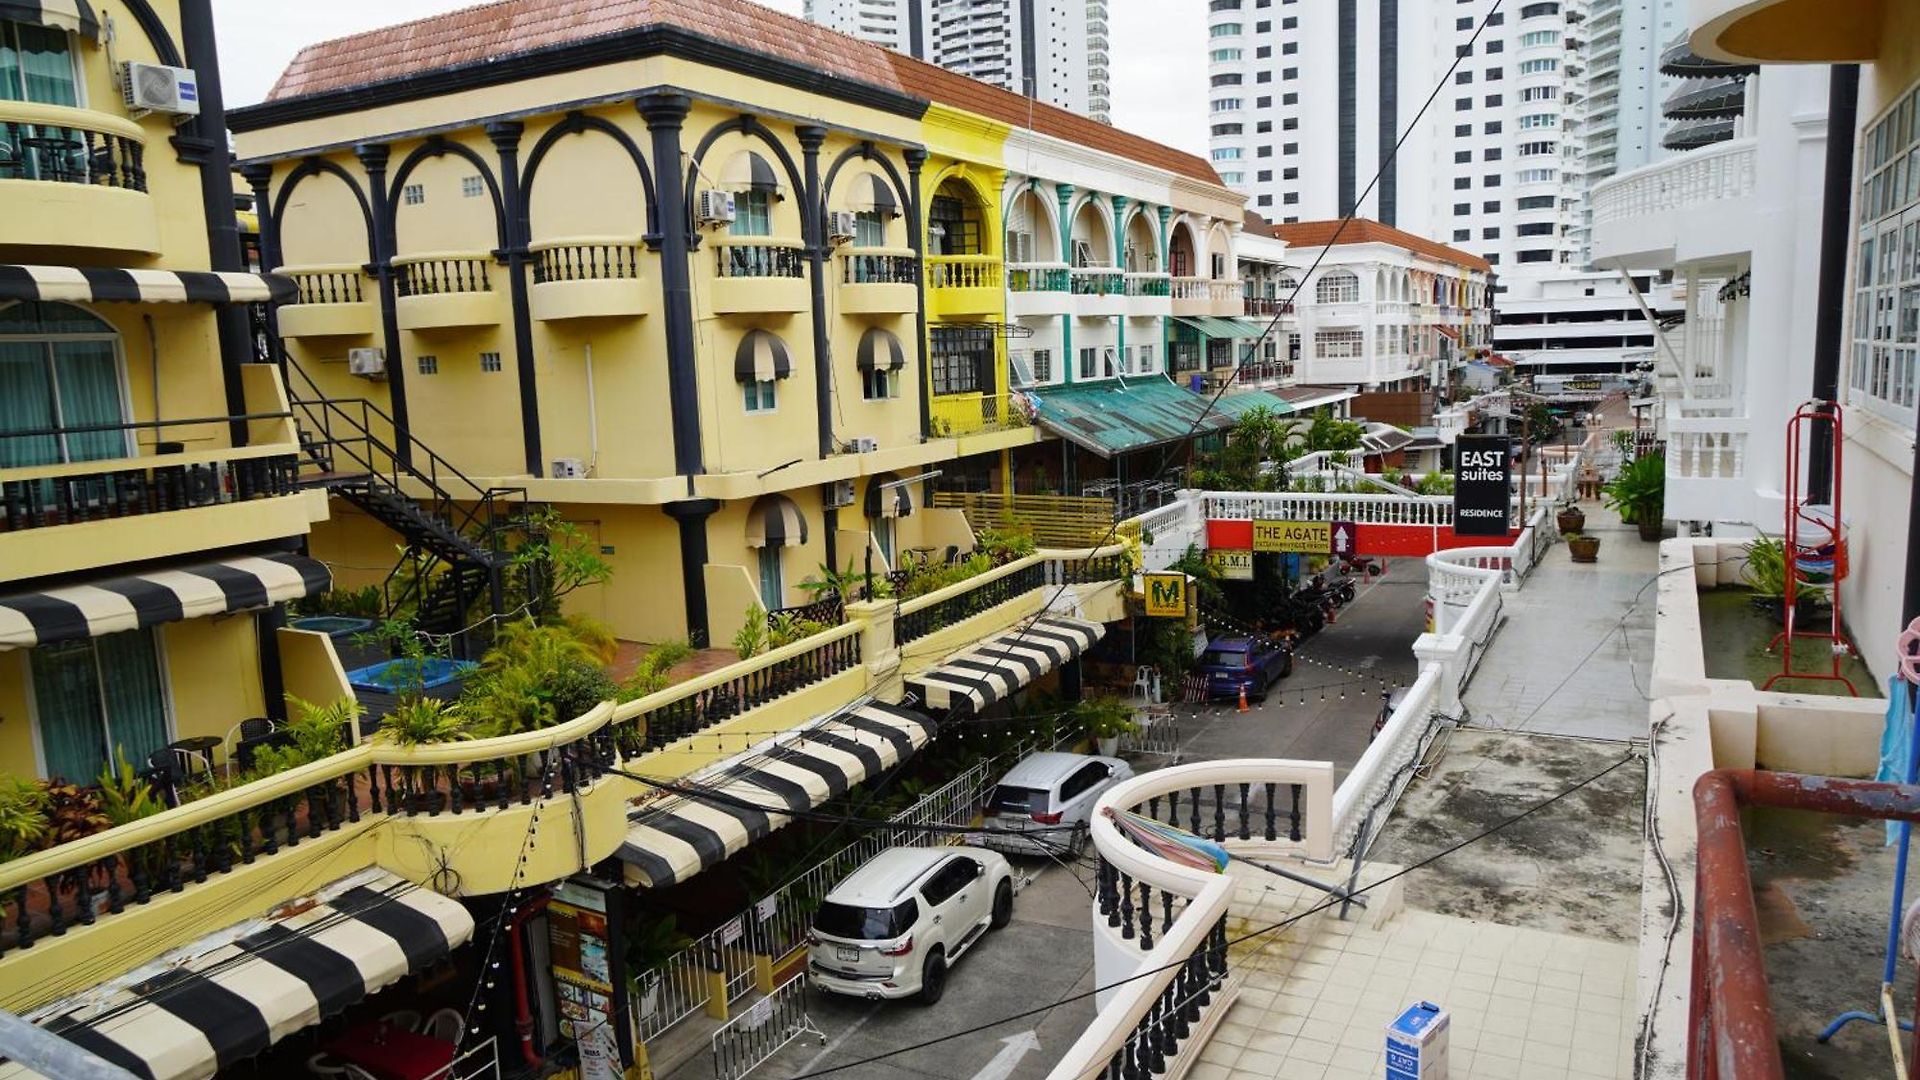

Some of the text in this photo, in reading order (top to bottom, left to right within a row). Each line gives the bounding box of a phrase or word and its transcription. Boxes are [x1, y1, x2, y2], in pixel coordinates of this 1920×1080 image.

[1461, 451, 1504, 467] EAST
[1461, 467, 1504, 481] suites
[1459, 508, 1504, 518] RESIDENCE
[1255, 526, 1328, 541] THE AGATE
